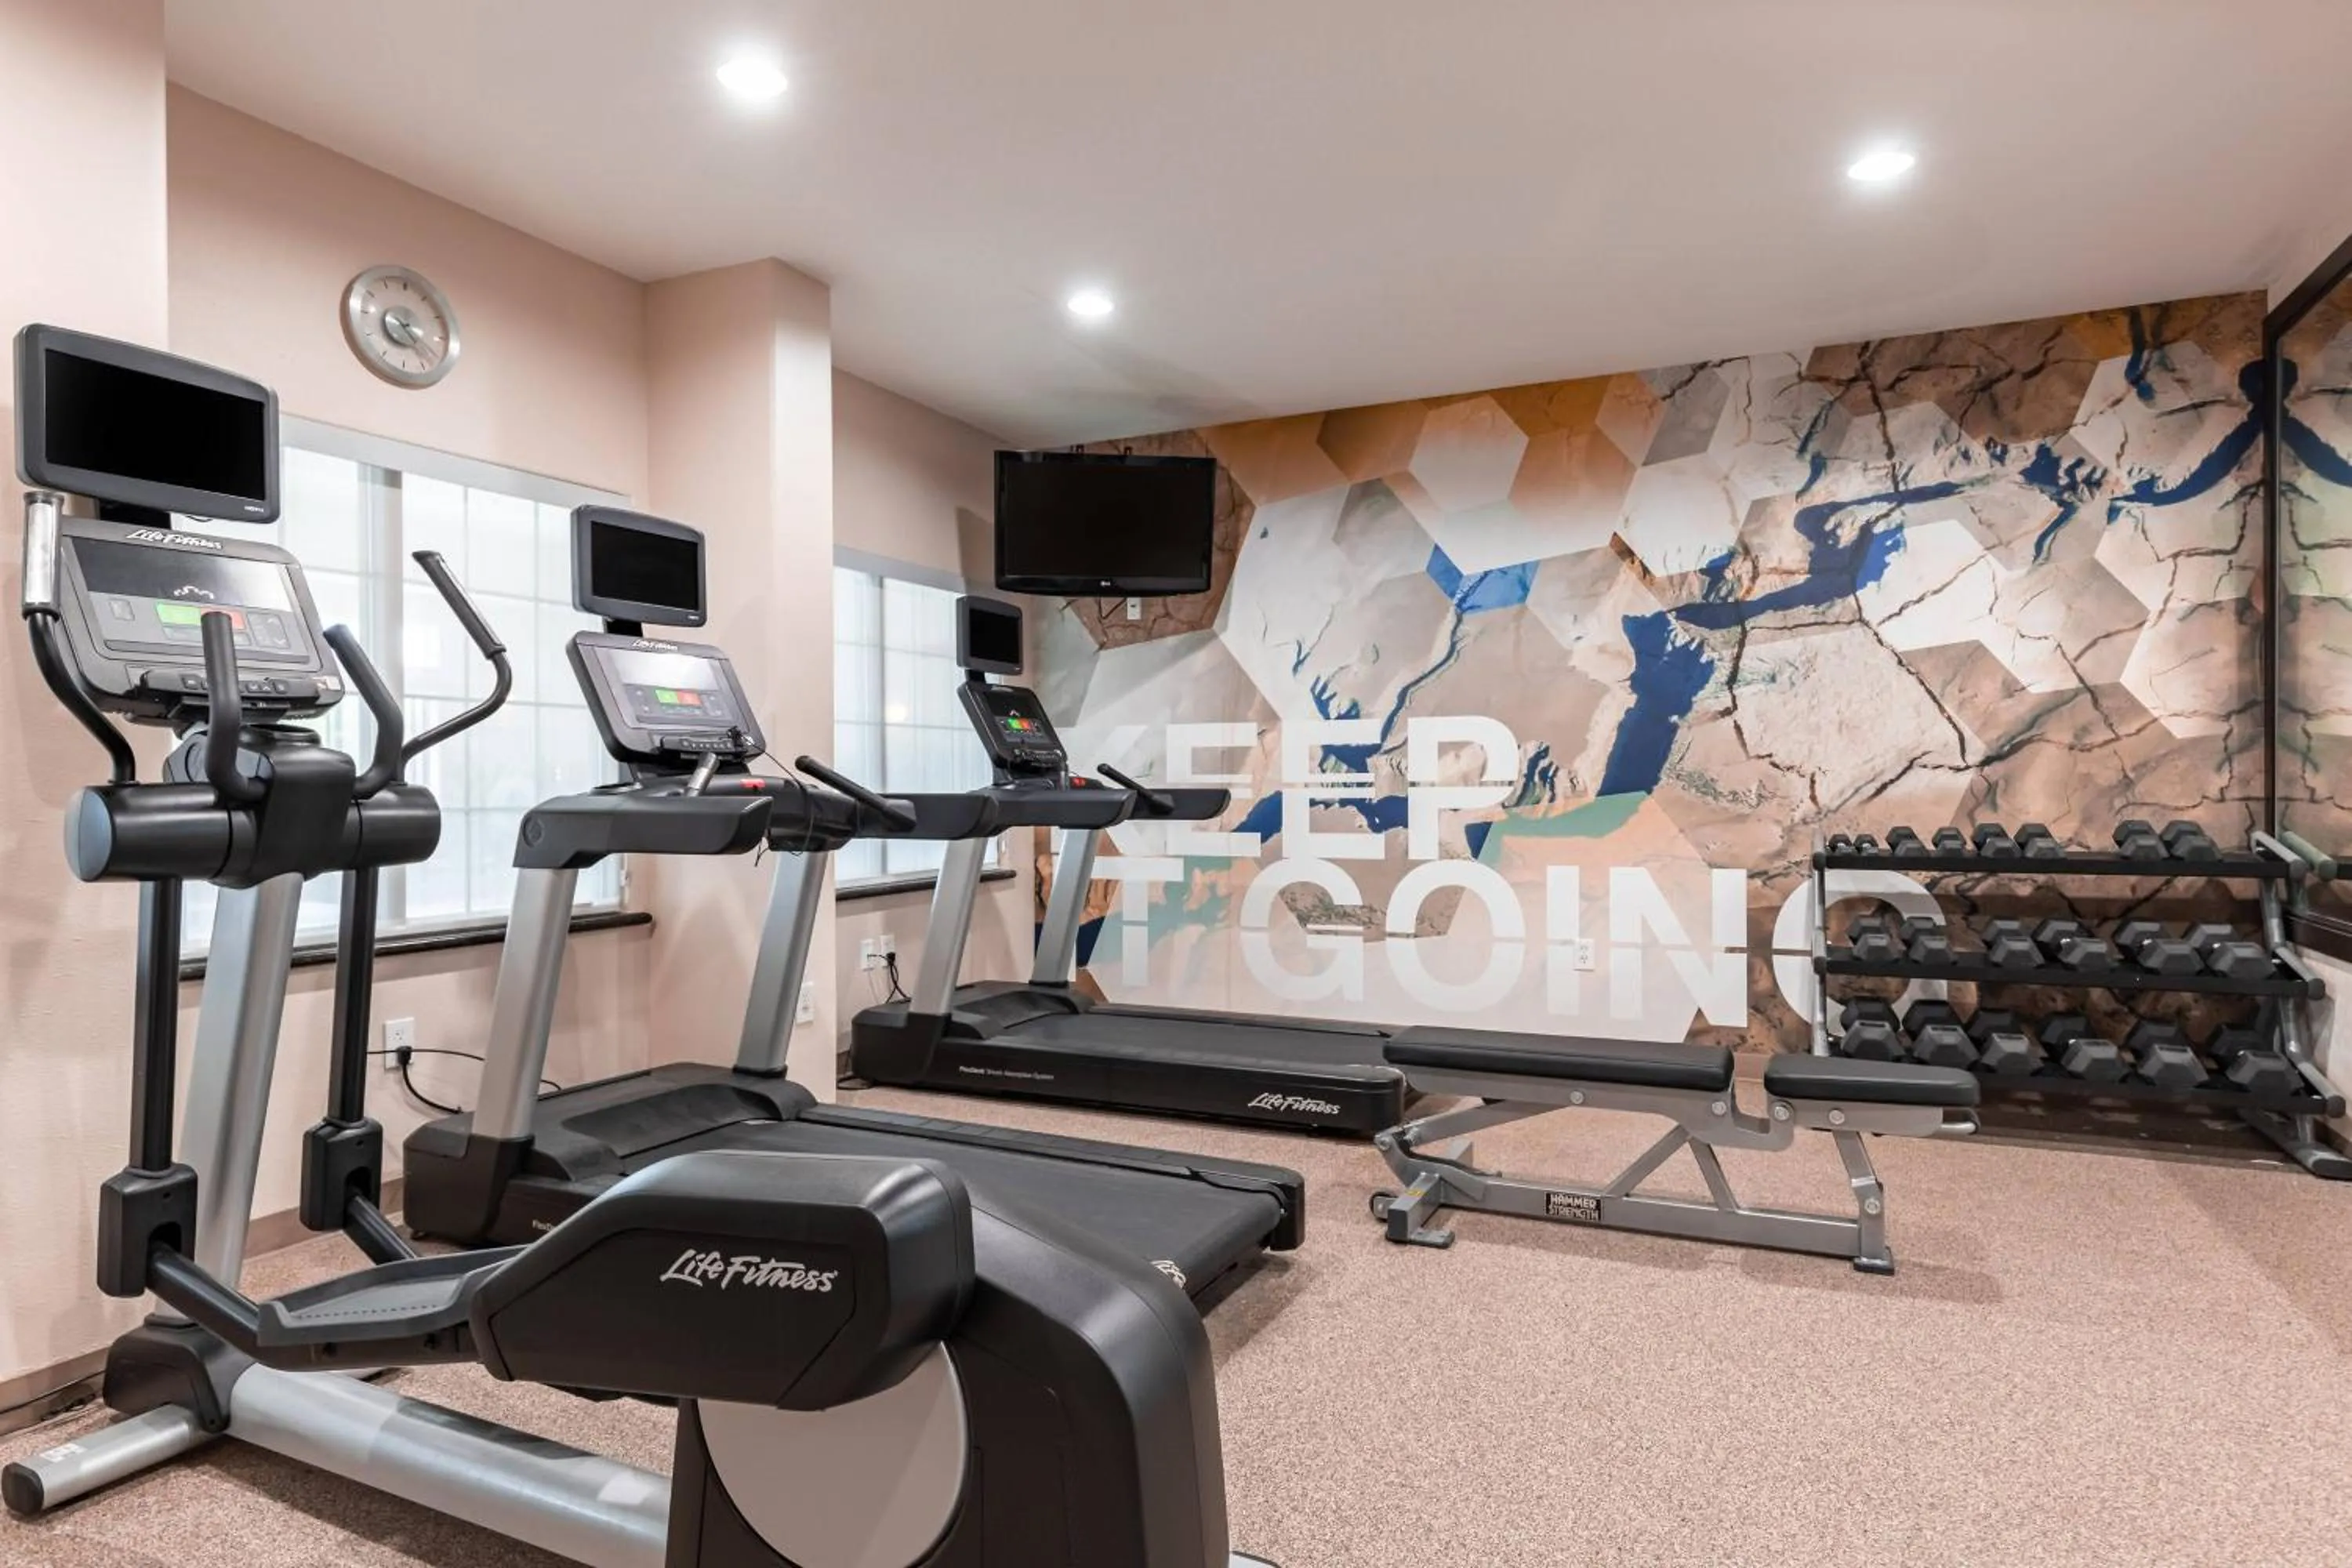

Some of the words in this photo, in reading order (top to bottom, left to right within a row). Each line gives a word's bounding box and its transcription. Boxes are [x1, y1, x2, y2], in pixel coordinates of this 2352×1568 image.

[1247, 1092, 1283, 1110] Life
[1550, 1193, 1597, 1210] HAMMER
[659, 1248, 724, 1287] Life
[720, 1255, 837, 1293] Fitness
